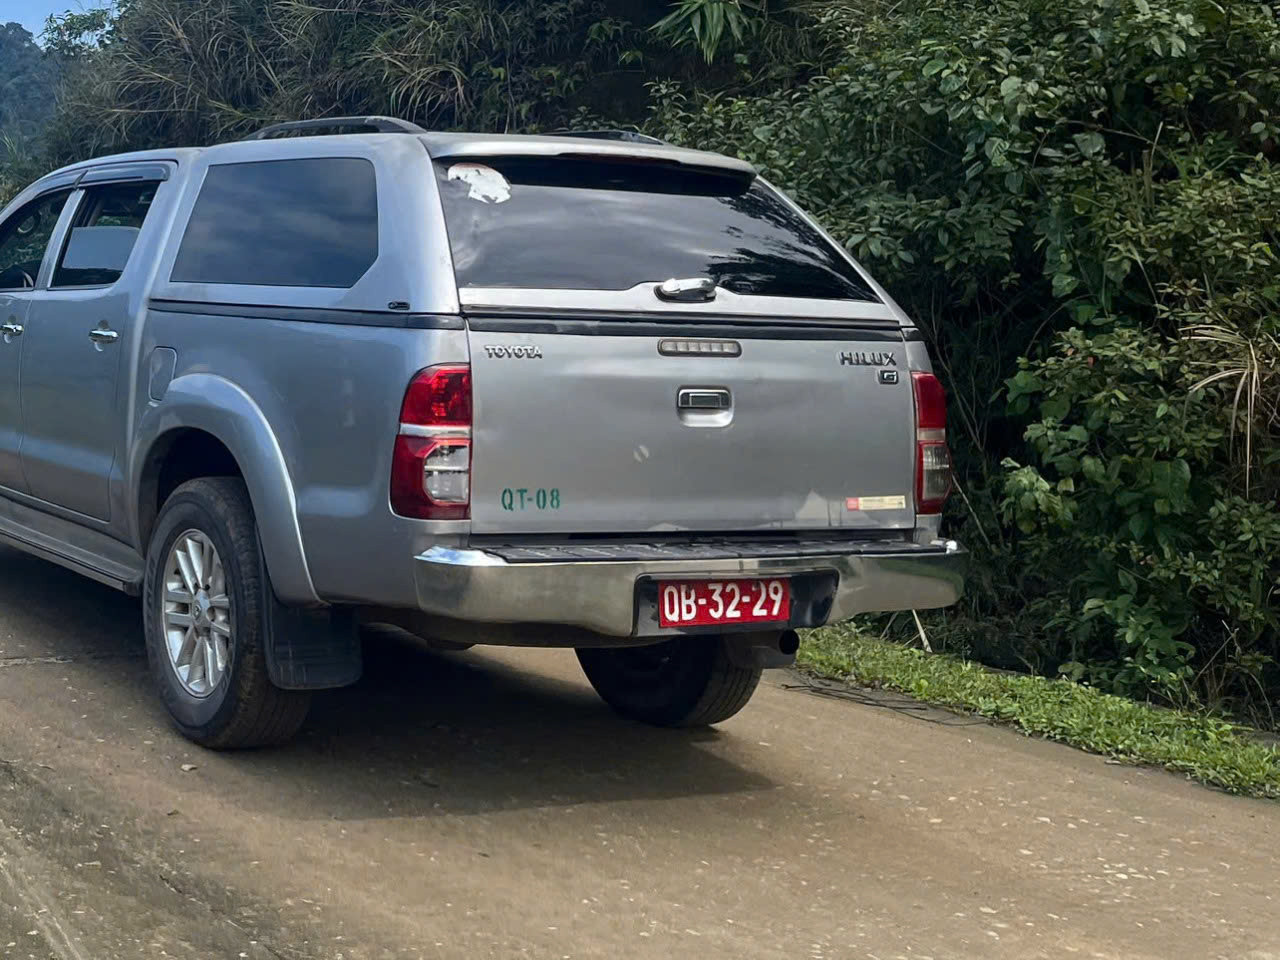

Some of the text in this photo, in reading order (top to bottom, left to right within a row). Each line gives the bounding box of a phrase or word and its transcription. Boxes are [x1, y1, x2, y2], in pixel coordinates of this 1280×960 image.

[484, 345, 543, 359] TOYOTA
[839, 351, 897, 366] HILUX
[501, 488, 561, 511] QT-08
[663, 581, 784, 622] QB-32-29
